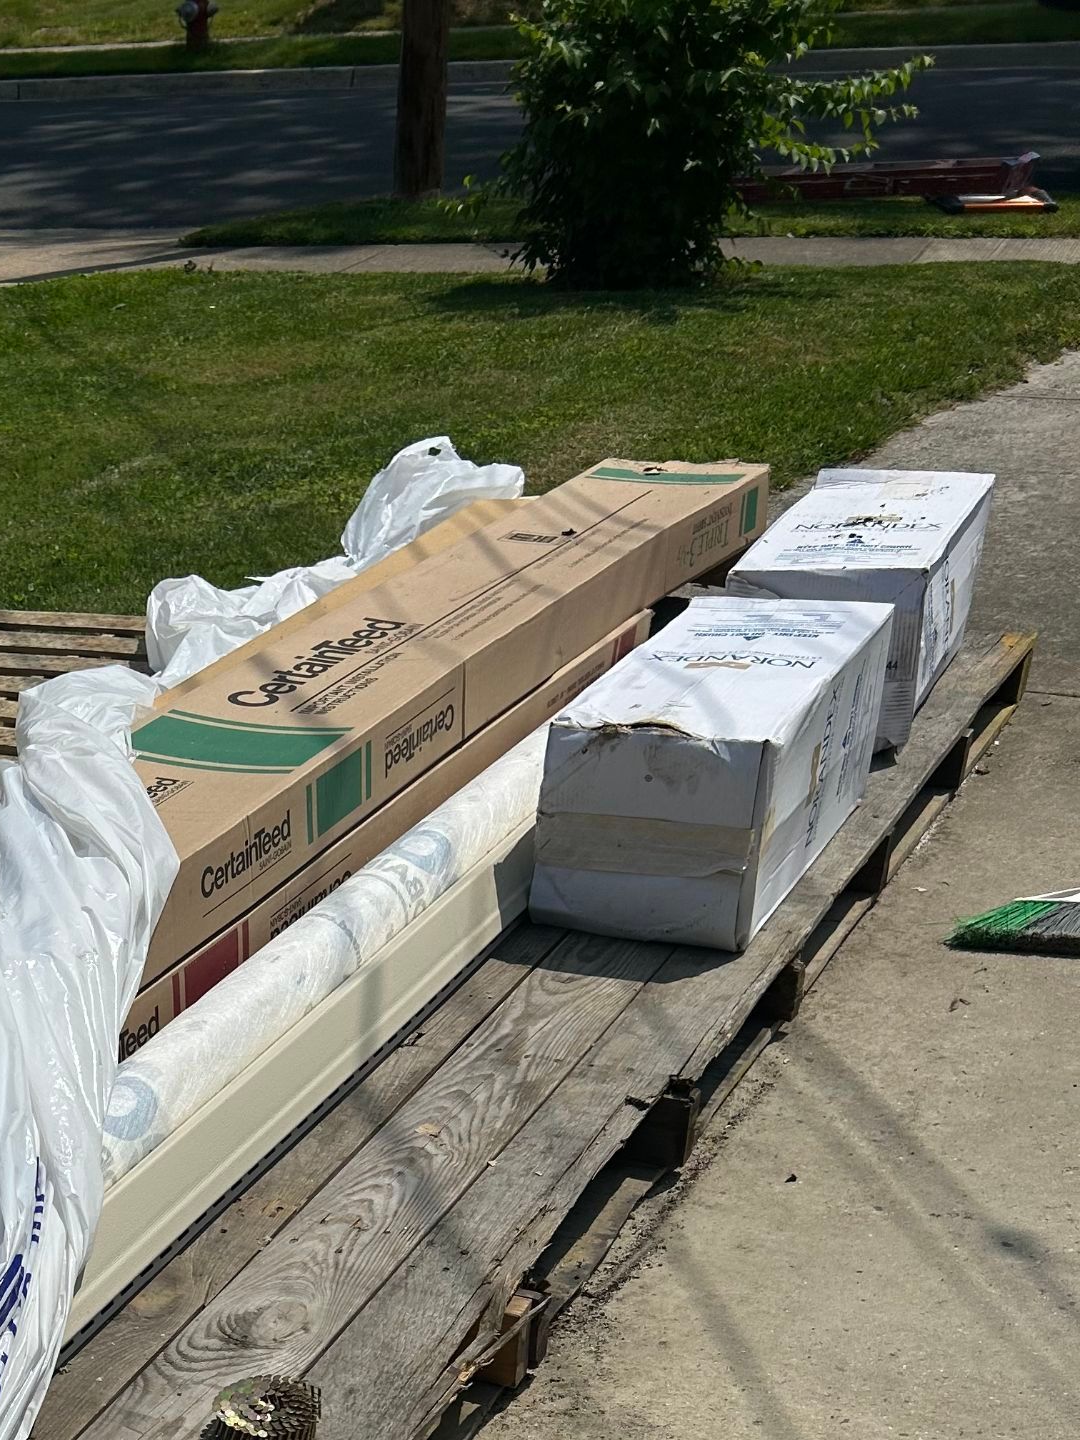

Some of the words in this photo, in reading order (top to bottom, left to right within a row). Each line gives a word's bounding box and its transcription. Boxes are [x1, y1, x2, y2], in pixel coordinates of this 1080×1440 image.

[228, 617, 407, 707] CertainTeed
[648, 653, 817, 669] NORANDEX
[384, 704, 455, 779] CertainTeed
[200, 808, 292, 899] CertainTeed
